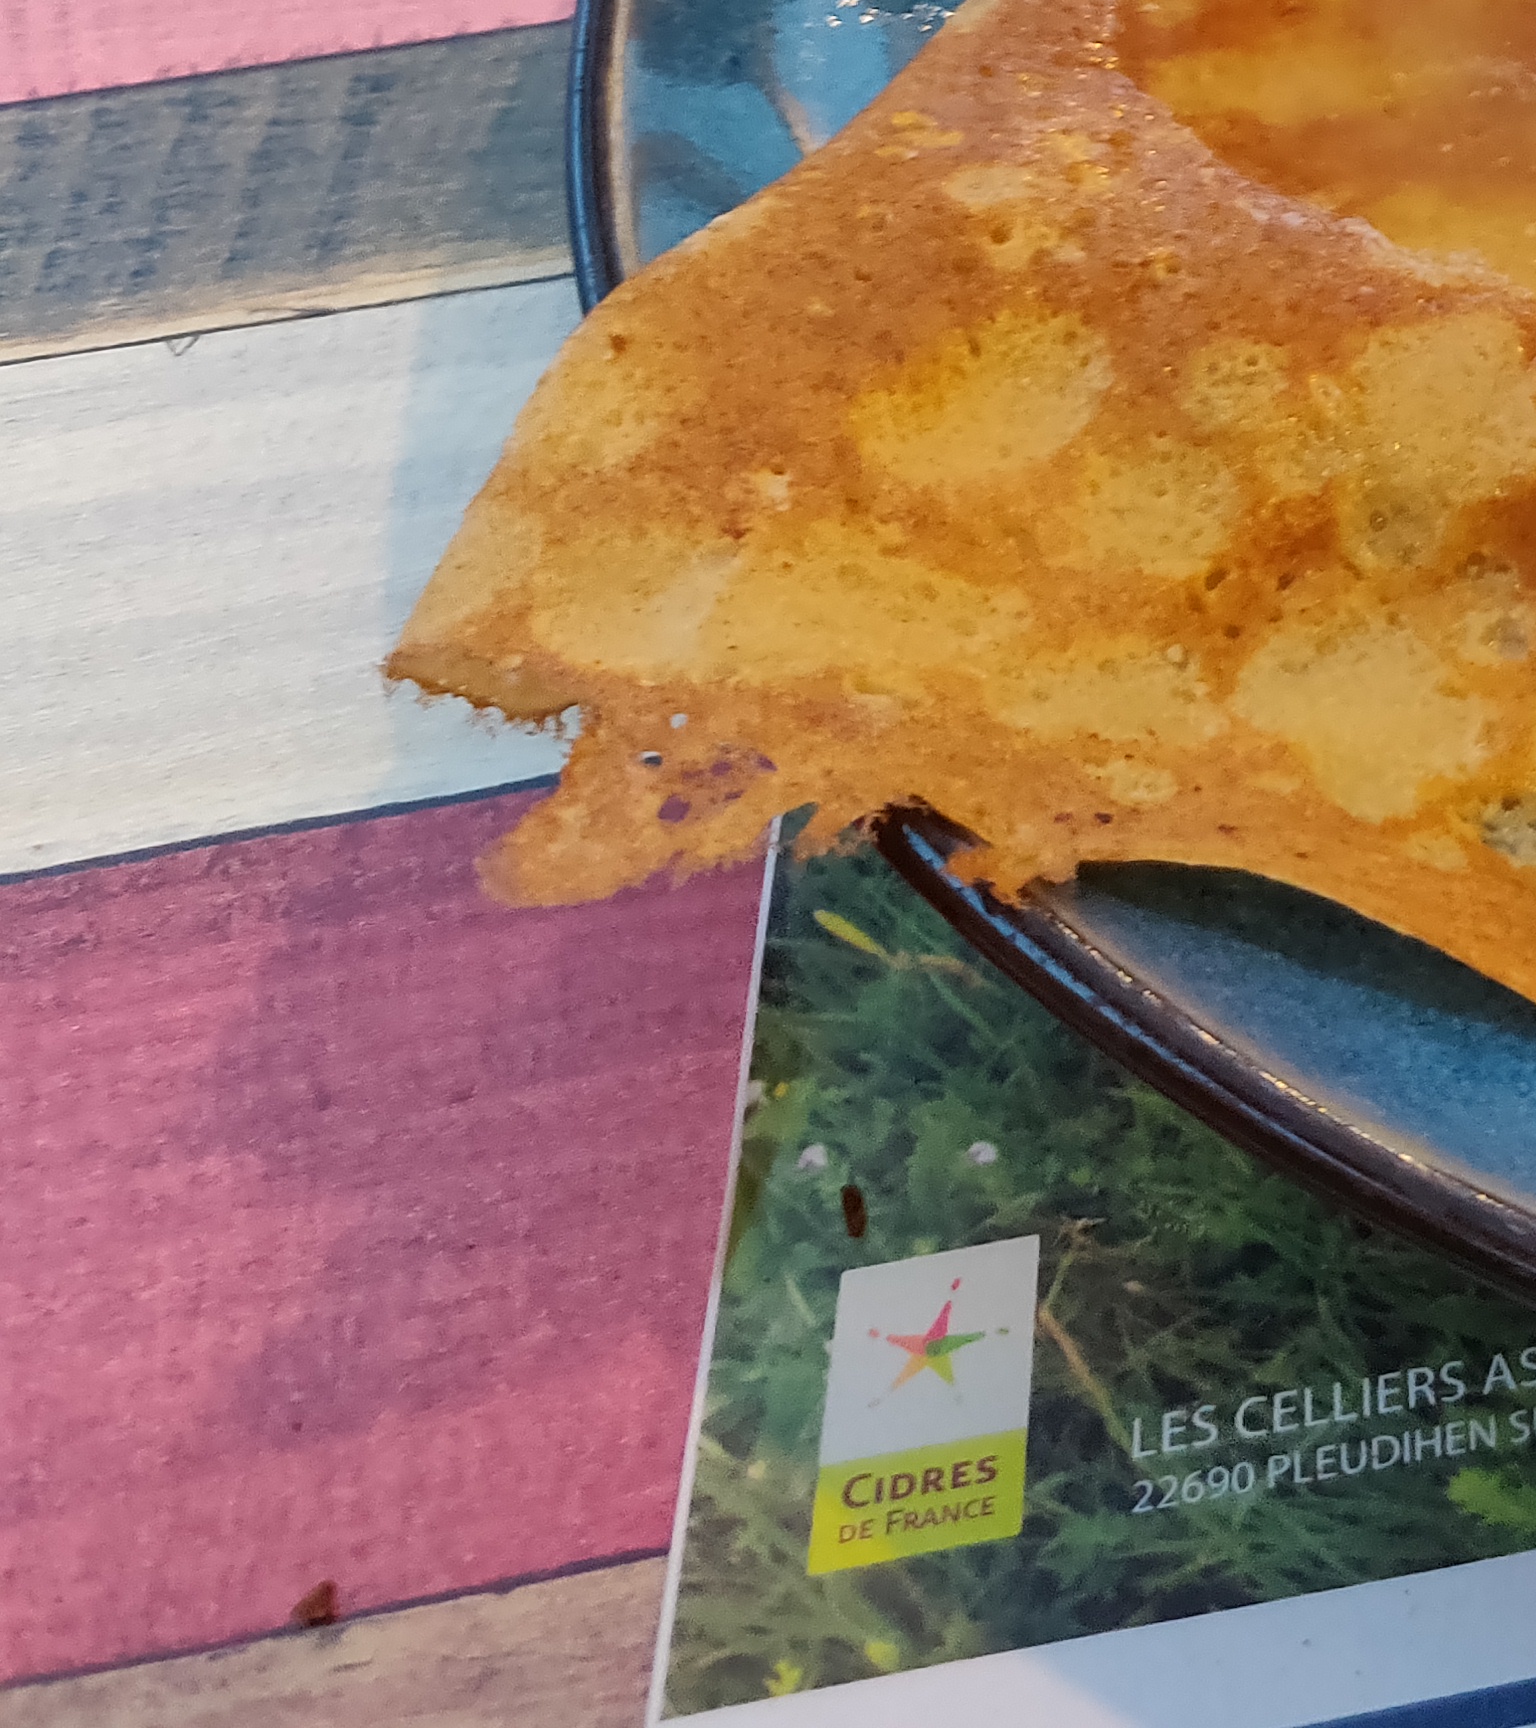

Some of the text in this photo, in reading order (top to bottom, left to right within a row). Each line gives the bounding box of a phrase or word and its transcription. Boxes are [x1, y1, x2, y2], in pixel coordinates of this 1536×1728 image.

[1131, 1404, 1219, 1459] LES
[1234, 1360, 1466, 1439] CELLIERS
[842, 1454, 998, 1508] CIDRES
[1131, 1463, 1256, 1514] 22690
[1266, 1417, 1498, 1488] PLEUDIHEN
[838, 1495, 996, 1544] DE FRANCE
